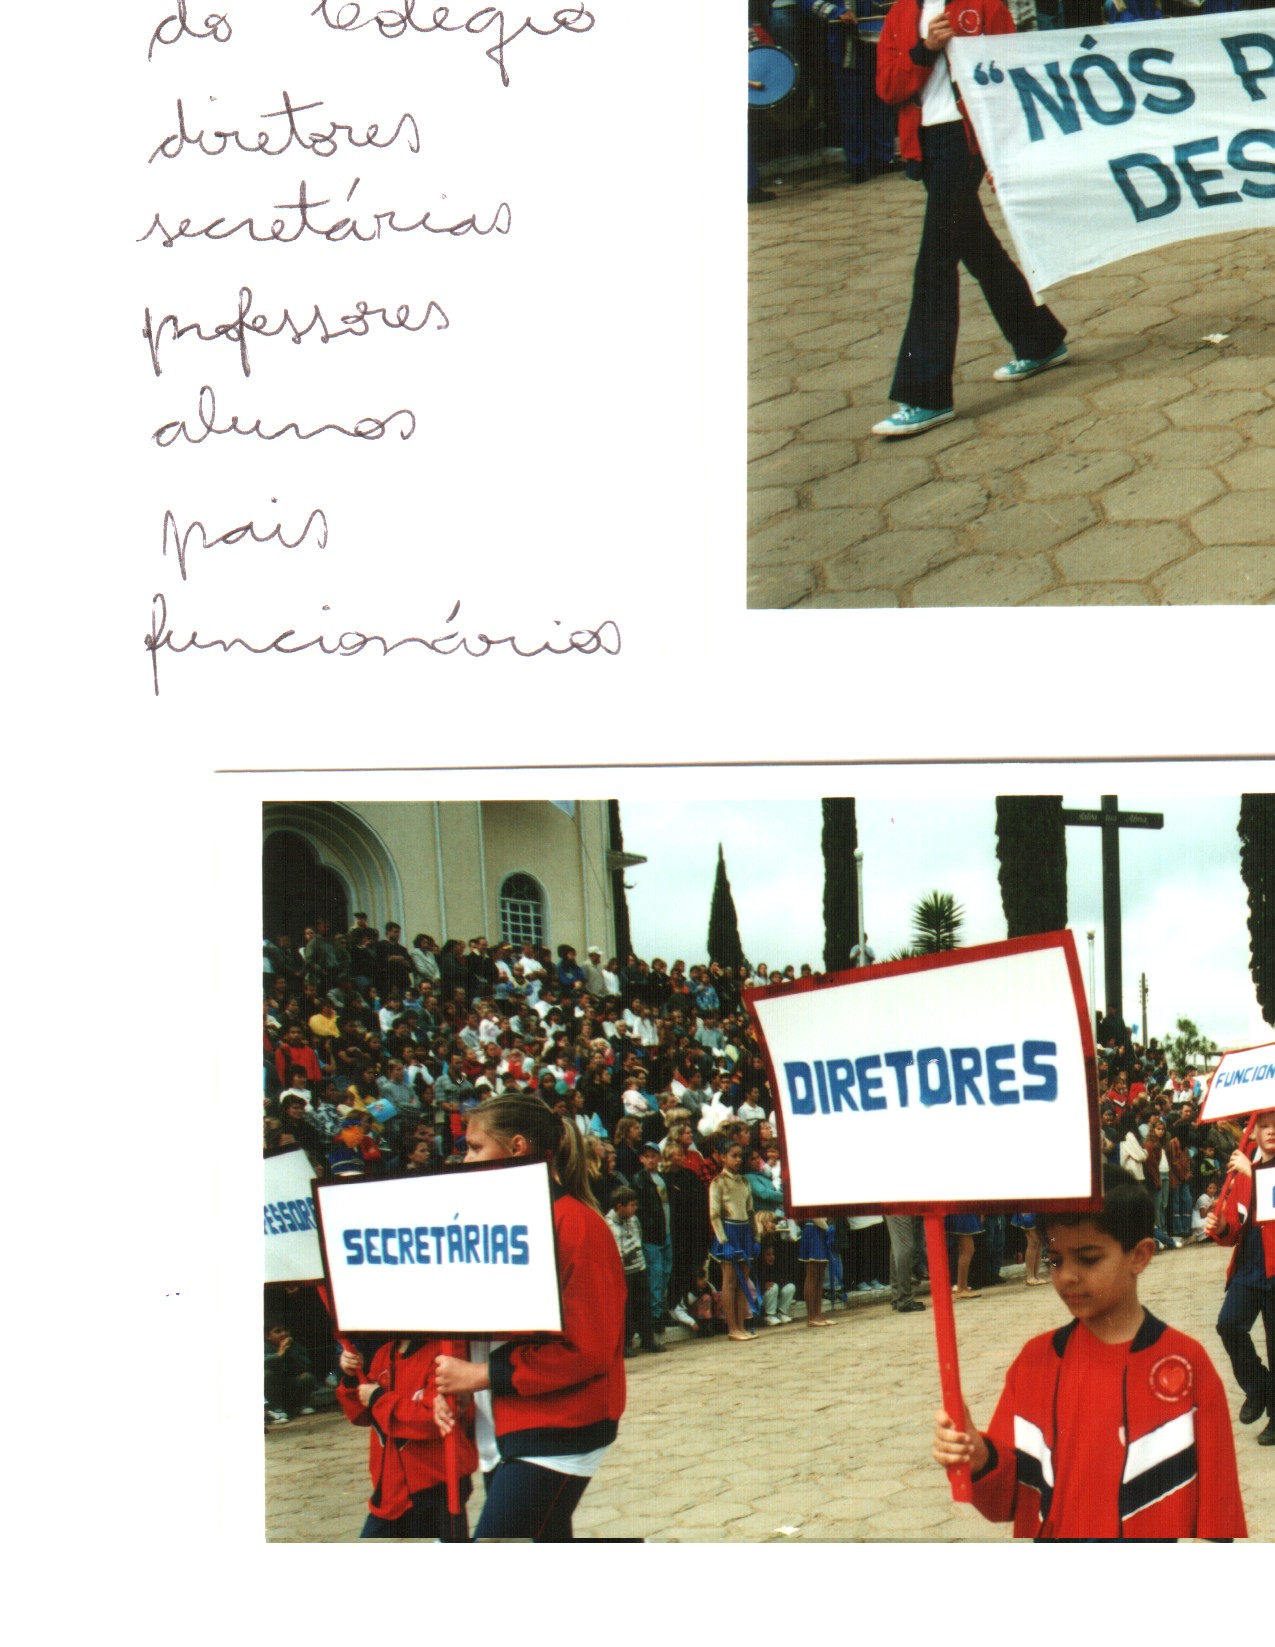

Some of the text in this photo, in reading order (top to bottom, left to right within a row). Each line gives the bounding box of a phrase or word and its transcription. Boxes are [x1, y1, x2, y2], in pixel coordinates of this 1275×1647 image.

[974, 34, 1196, 142] "NÓS
[148, 91, 420, 164] diretores
[136, 177, 511, 248] secretárias
[142, 286, 449, 377] professores
[151, 385, 416, 447] alunos
[163, 497, 328, 581] pais
[144, 593, 621, 696] funcionários
[783, 1040, 1058, 1115] DIRETORES
[342, 1212, 530, 1266] SECRETÁRIAS
